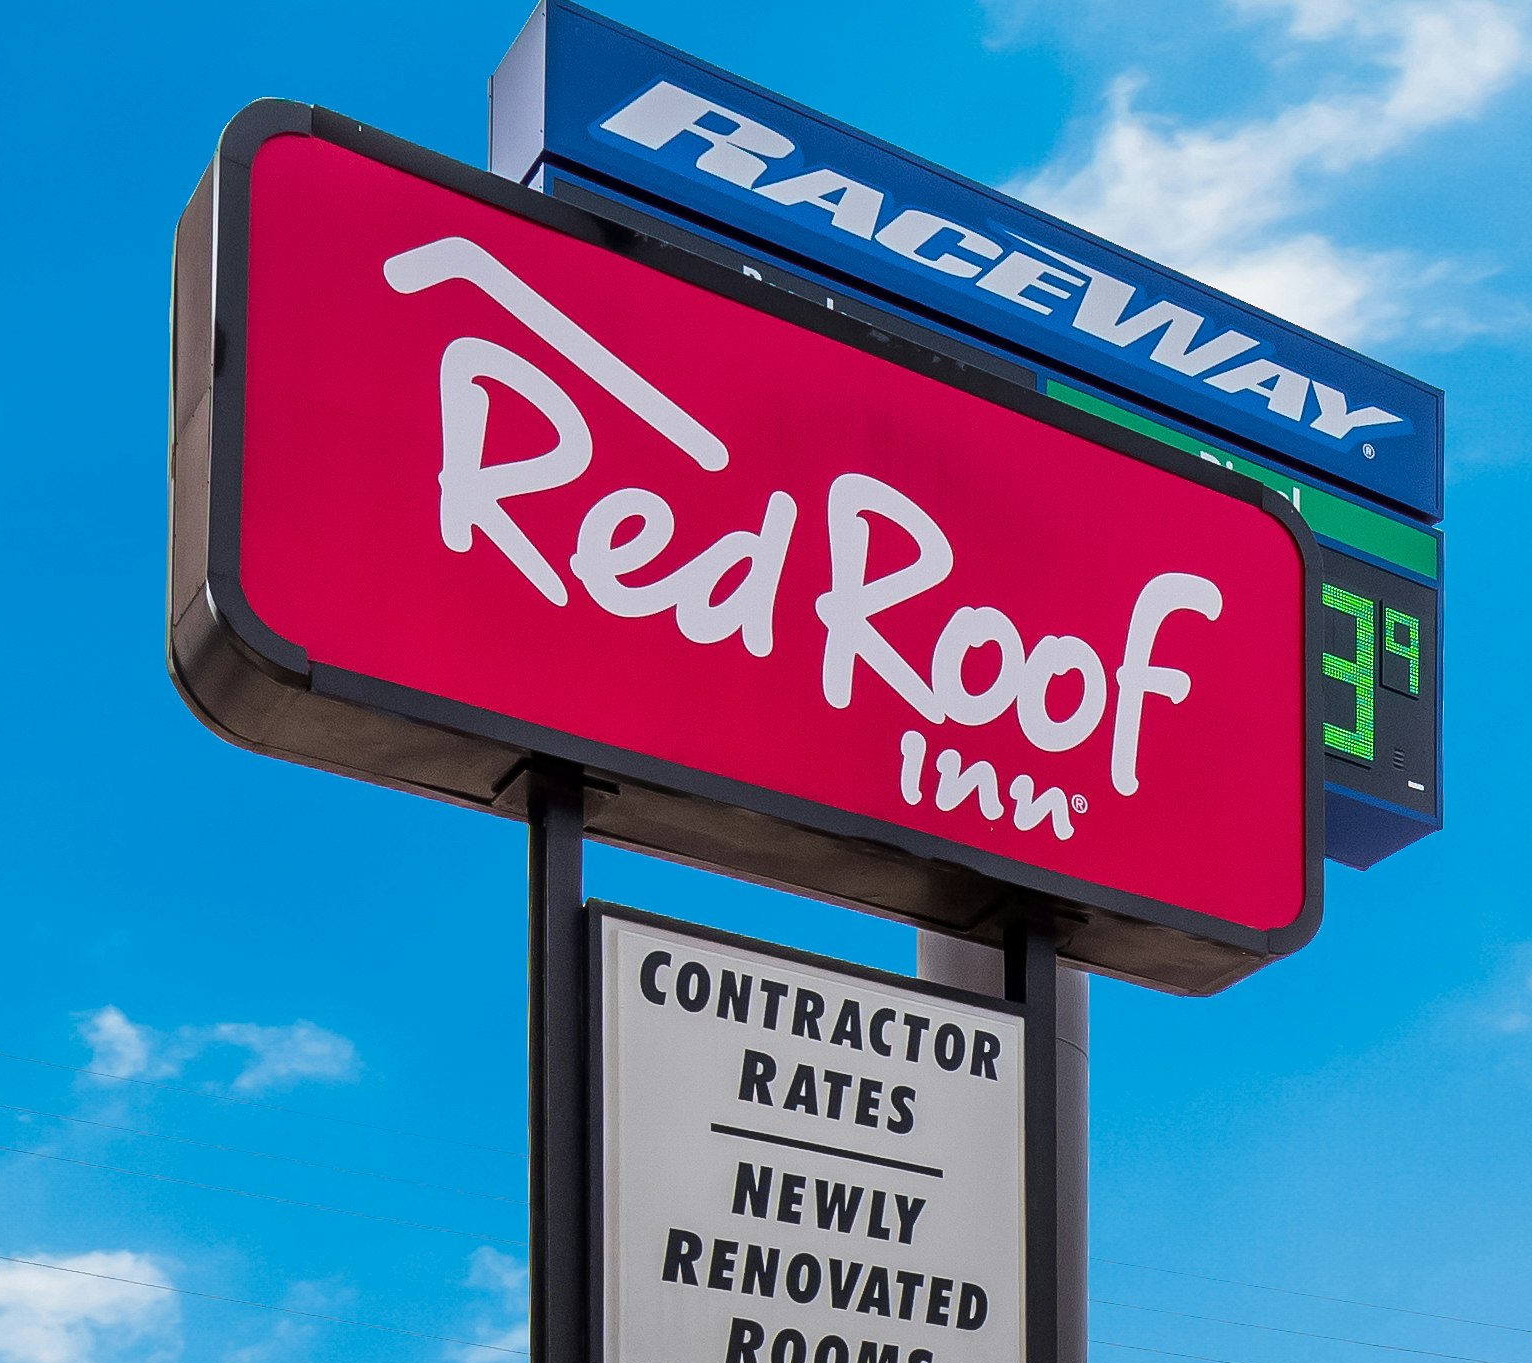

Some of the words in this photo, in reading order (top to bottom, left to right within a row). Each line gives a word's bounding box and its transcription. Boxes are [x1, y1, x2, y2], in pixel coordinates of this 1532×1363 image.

[439, 337, 797, 658] Red
[816, 472, 1223, 796] Roof
[639, 950, 1001, 1081] CONTRACTOR
[737, 1049, 917, 1135] RATES
[732, 1161, 927, 1245] NEWLY
[661, 1228, 989, 1331] RENOVATED
